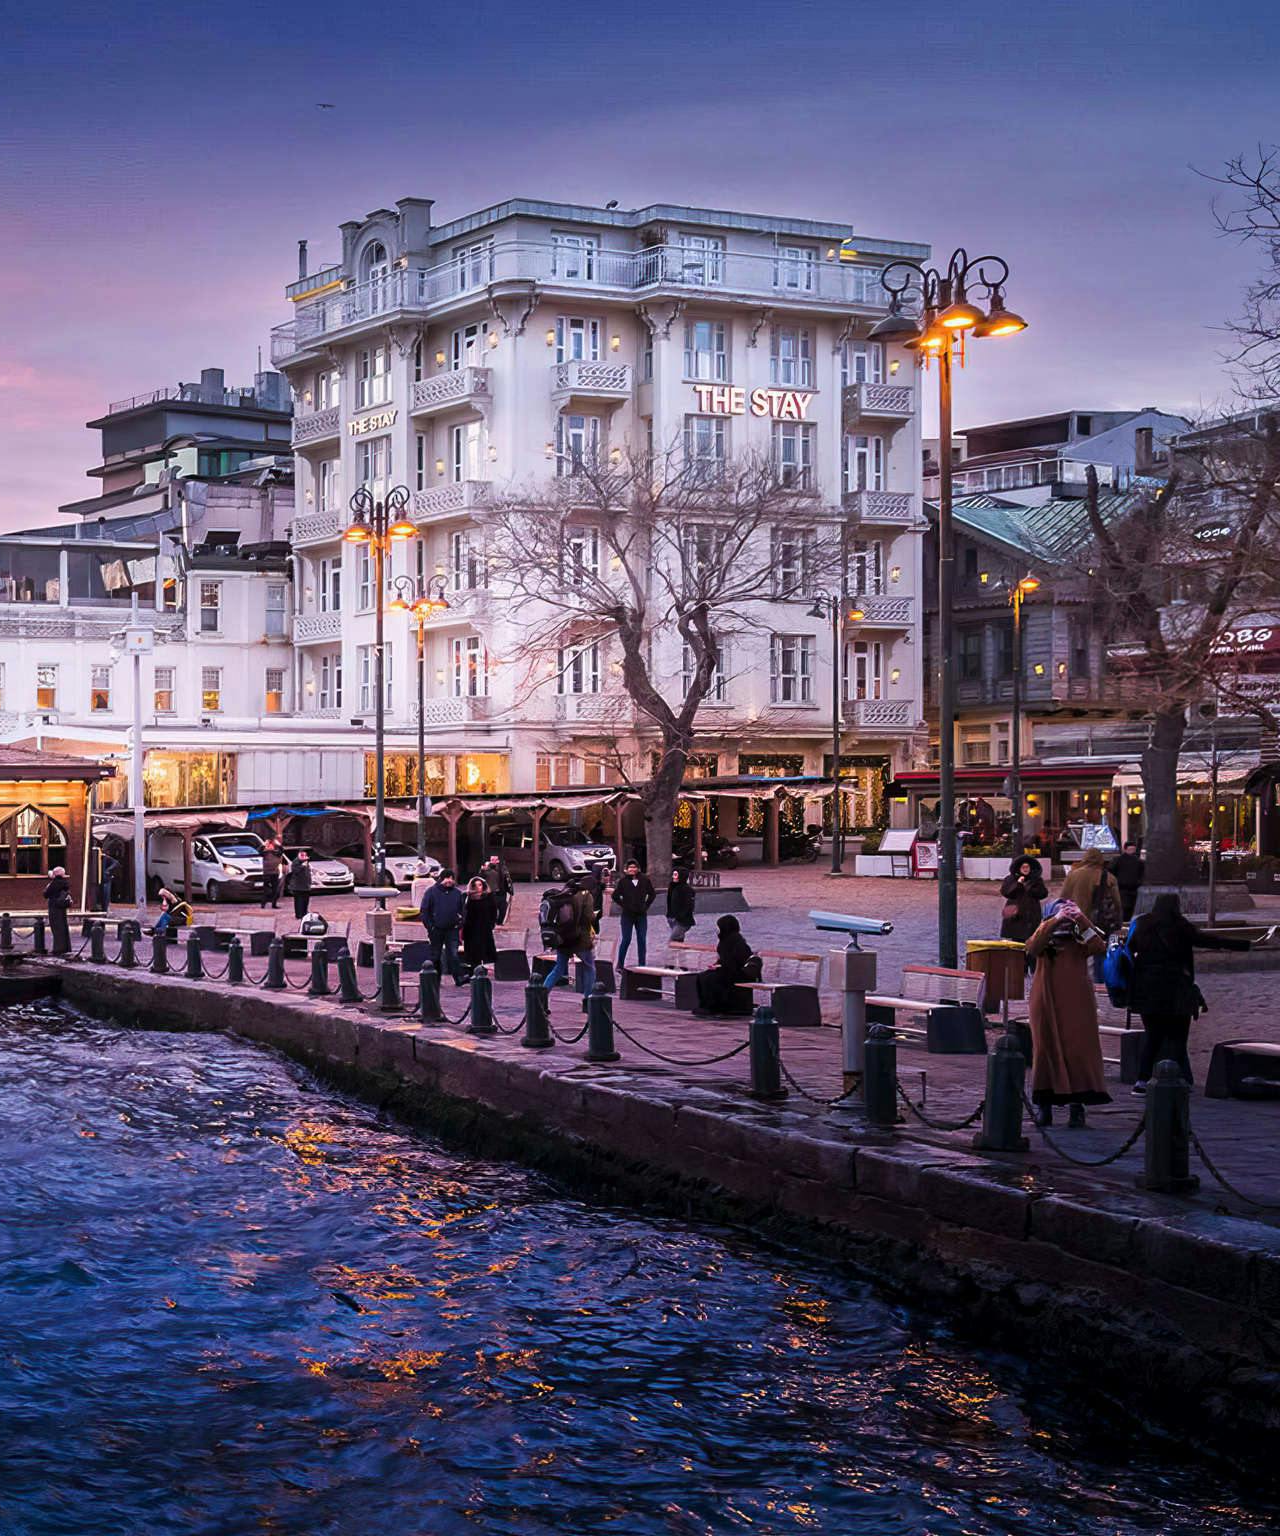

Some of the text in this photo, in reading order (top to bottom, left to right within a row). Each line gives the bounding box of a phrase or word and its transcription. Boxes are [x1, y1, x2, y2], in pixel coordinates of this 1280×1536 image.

[694, 384, 813, 419] THE STAY
[348, 410, 398, 436] THE STAY
